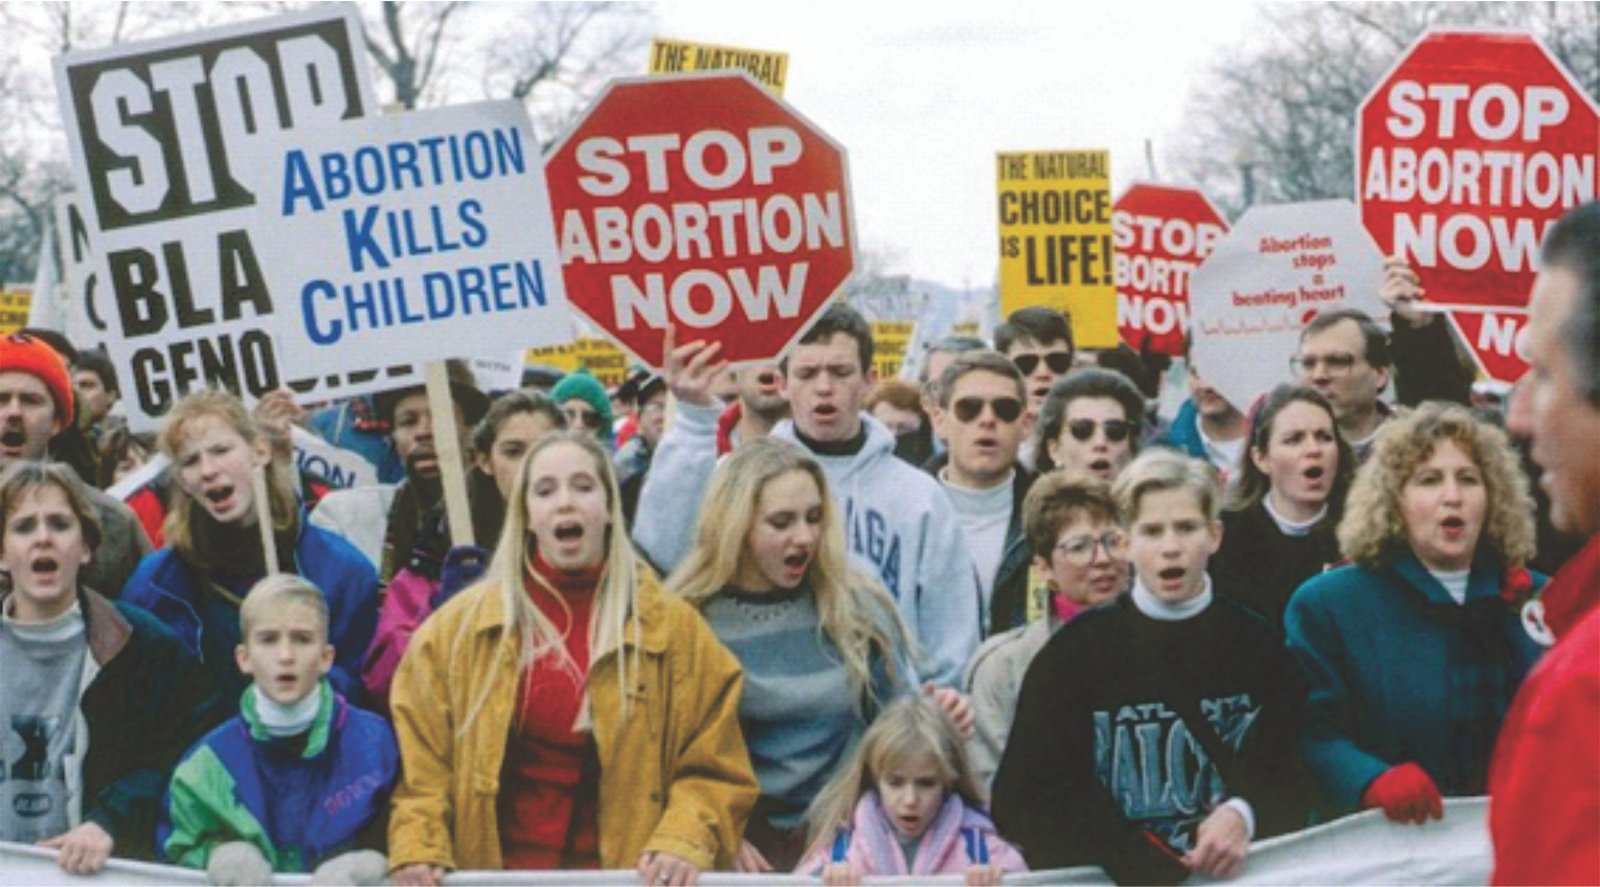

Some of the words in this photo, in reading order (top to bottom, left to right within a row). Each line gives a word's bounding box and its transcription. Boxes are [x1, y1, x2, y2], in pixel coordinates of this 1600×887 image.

[653, 43, 685, 72] THE
[90, 33, 349, 216] STOP
[1385, 80, 1570, 142] STOP
[282, 127, 525, 216] ABORTION
[575, 125, 803, 196] STOP
[999, 156, 1027, 179] THE
[1033, 154, 1107, 179] NATURAL
[1365, 146, 1595, 209] ABORTION
[343, 199, 488, 273] KILLS
[560, 190, 845, 265] ABORTION
[1000, 189, 1111, 225] CHOICE
[1113, 210, 1223, 258] STOP
[1001, 236, 1019, 258] IS
[1026, 234, 1113, 286] LIFE!
[1259, 234, 1333, 253] Abortion
[1294, 253, 1336, 270] stops
[108, 229, 273, 338] BLA
[301, 259, 547, 345] CHILDREN
[610, 262, 809, 330] NOW
[1232, 290, 1297, 308] beating
[1299, 285, 1345, 302] heart
[1313, 273, 1324, 286] a
